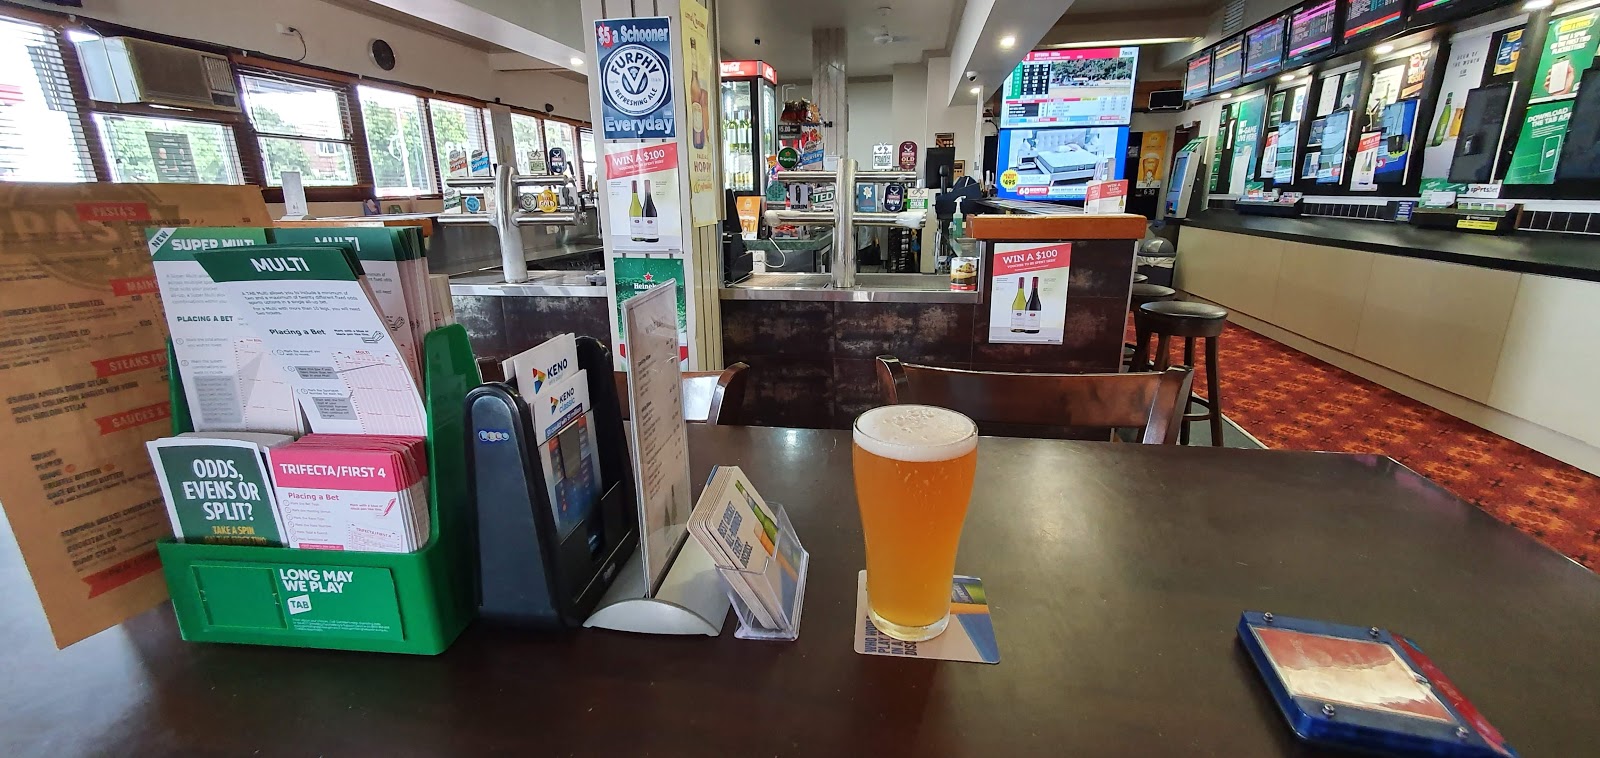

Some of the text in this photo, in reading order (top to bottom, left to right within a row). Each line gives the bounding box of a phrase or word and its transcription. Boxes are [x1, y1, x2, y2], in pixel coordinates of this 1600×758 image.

[598, 25, 669, 45] $5 a Schooner
[611, 52, 660, 76] FURPHY
[615, 88, 657, 106] REFRESHING ALE
[1527, 107, 1568, 123] DOWNLOAD
[1532, 119, 1543, 127] THE
[1545, 116, 1558, 124] TAB
[605, 116, 673, 134] Everyday
[613, 149, 665, 166] WIN A $100
[694, 161, 712, 173] HOPPY
[814, 191, 833, 202] TED
[1018, 187, 1030, 195] 60
[1470, 185, 1498, 193] sportsbet
[92, 206, 137, 217] PASTA'S
[151, 230, 169, 248] NEW
[171, 238, 219, 251] SUPER
[1002, 249, 1058, 264] WIN A $100
[250, 257, 310, 273] MULTI
[269, 329, 302, 337] Placing
[109, 357, 147, 373] STEAKS
[547, 358, 568, 378] KENO
[559, 387, 575, 404] KENO
[559, 397, 576, 413] classic
[111, 410, 154, 428] SAUCES
[193, 459, 244, 482] ODDS,
[279, 464, 386, 479] TRIFECTA/FIRST 4
[183, 481, 261, 502] EVENS OR
[288, 492, 317, 502] Placing
[203, 501, 254, 522] SPLIT?
[212, 526, 255, 536] TAKE A SPIN
[280, 568, 354, 582] LONG MAY
[282, 580, 344, 593] WE PLAY
[290, 600, 310, 609] TAB
[864, 637, 878, 653] WHO
[878, 636, 891, 653] PLAY
[891, 646, 904, 655] IN
